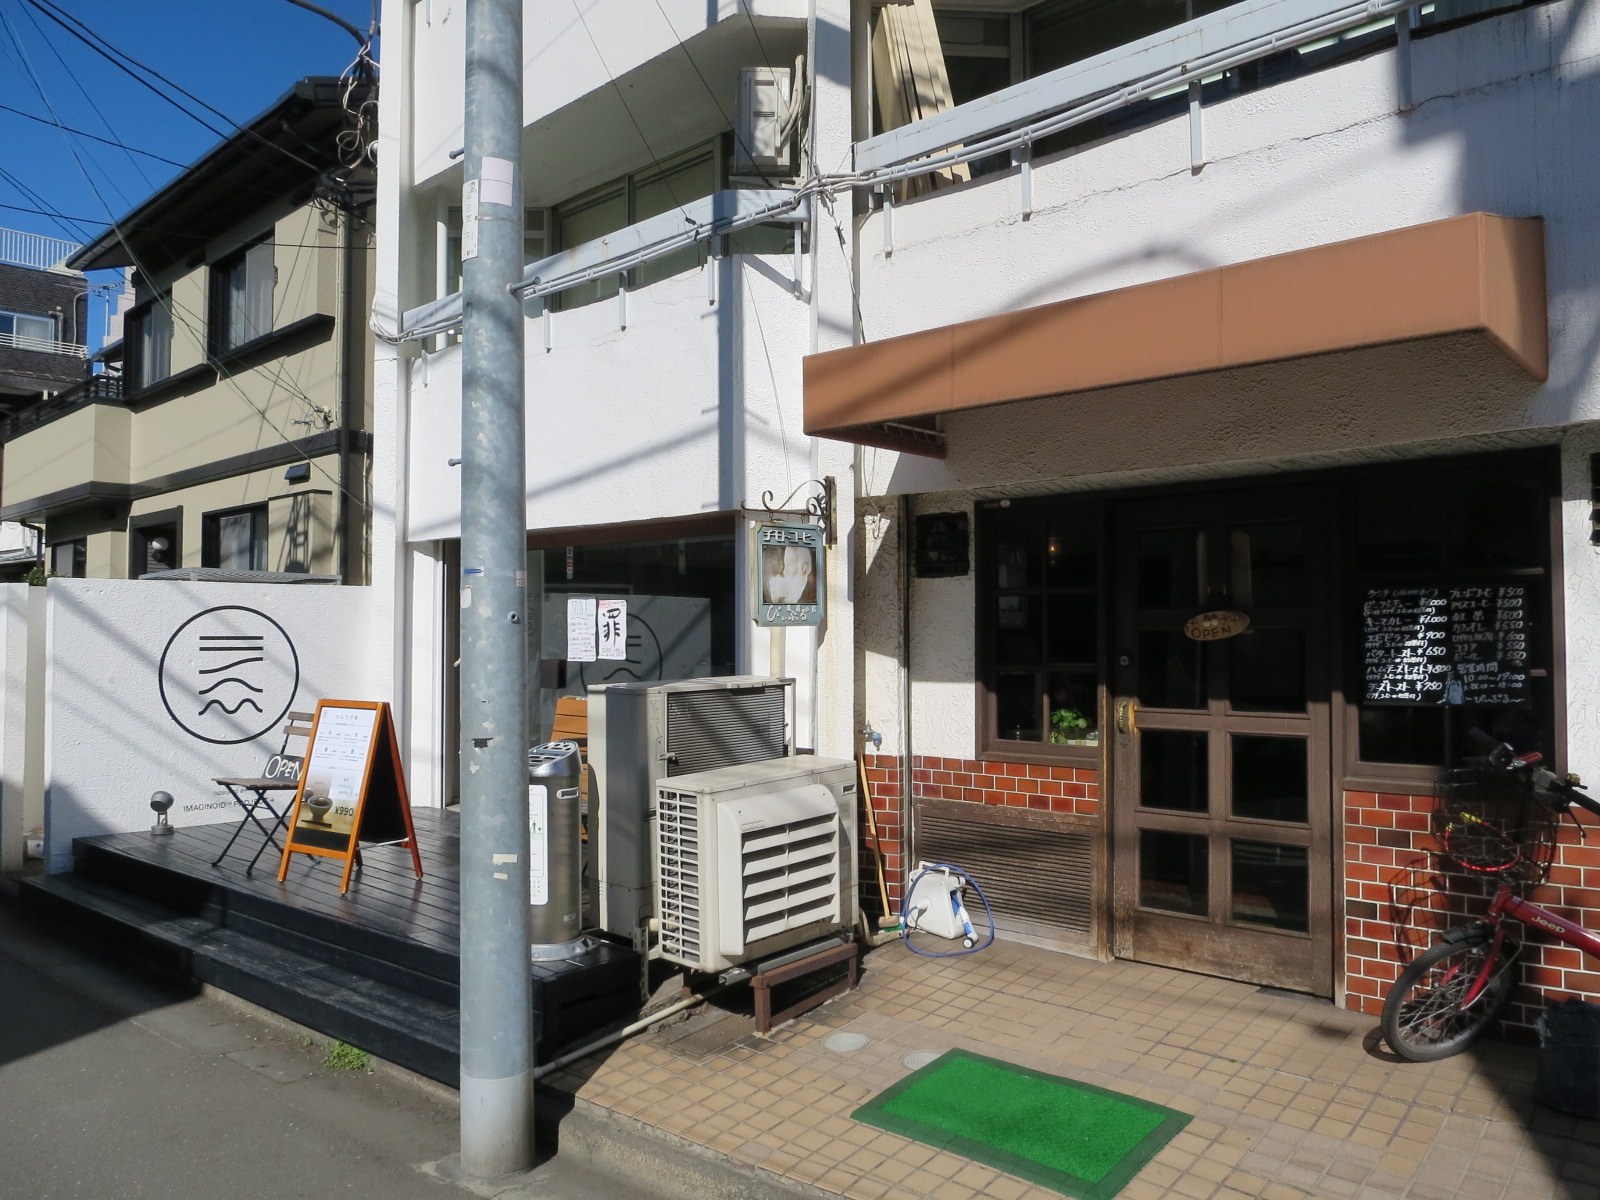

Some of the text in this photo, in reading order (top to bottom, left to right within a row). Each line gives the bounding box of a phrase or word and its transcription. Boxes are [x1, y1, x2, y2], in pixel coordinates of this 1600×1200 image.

[1499, 587, 1524, 597] ¥500
[1496, 598, 1522, 608] ¥500
[1497, 610, 1523, 619] ¥500
[602, 607, 622, 647] 罪
[1191, 625, 1231, 639] OPEN
[1367, 633, 1410, 643] エビピラフ
[1417, 631, 1446, 640] ¥900
[1498, 631, 1525, 641] ¥600
[1496, 641, 1525, 650] ¥550
[1416, 647, 1446, 656] ¥650
[1496, 651, 1526, 660] ¥550
[1426, 664, 1451, 674] ¥800
[1457, 661, 1498, 674] 営業時間
[265, 755, 304, 781] OPEN
[183, 801, 226, 812] IMAGINOID
[335, 806, 354, 817] ¥990
[1531, 916, 1566, 934] Jeep
